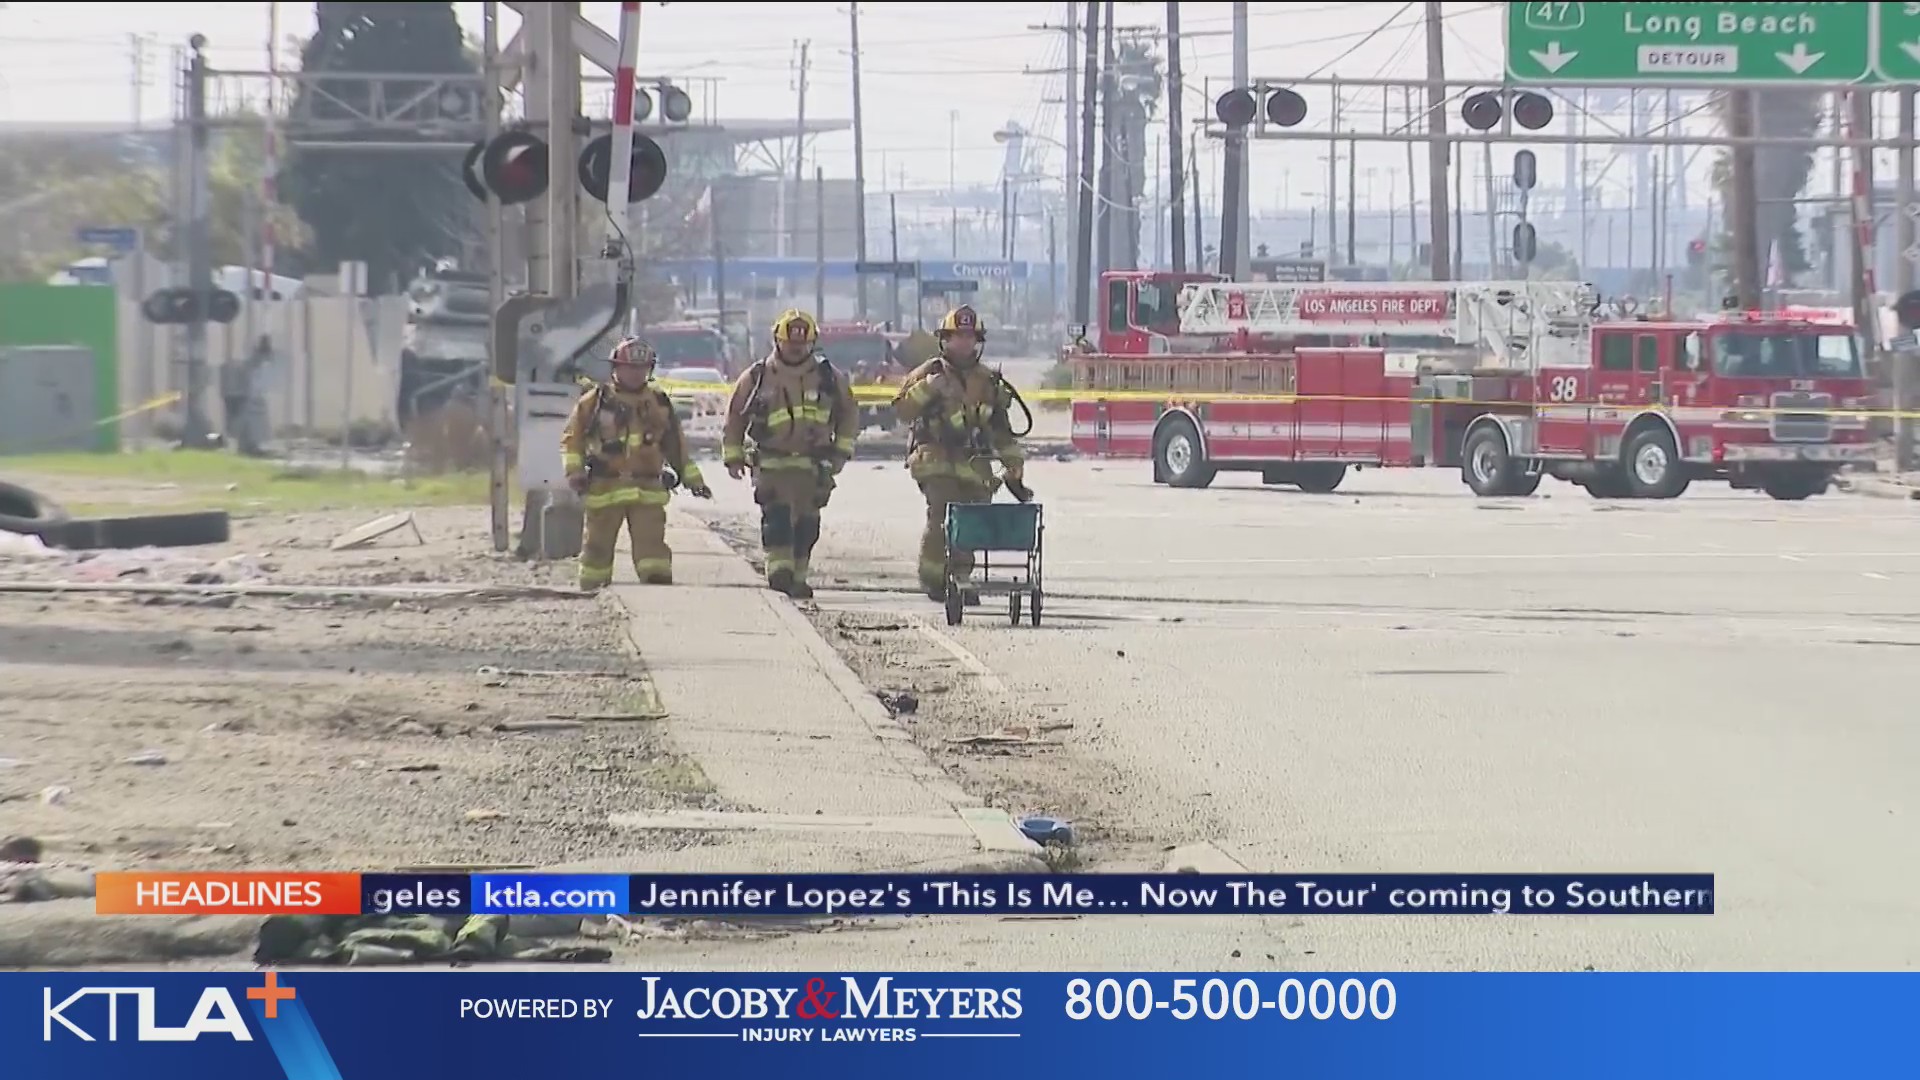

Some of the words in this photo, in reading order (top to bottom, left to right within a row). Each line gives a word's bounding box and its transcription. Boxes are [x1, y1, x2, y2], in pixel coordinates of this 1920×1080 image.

[1536, 2, 1570, 21] 47
[1624, 12, 1702, 40] Long
[1718, 12, 1816, 33] Beach
[1648, 52, 1726, 66] DETOUR
[952, 263, 1010, 277] Chevron
[1304, 299, 1326, 314] LOS
[1329, 299, 1378, 314] ANGELES
[1381, 299, 1405, 314] FIRE
[1410, 299, 1440, 314] DEPT.
[1550, 376, 1577, 401] 38
